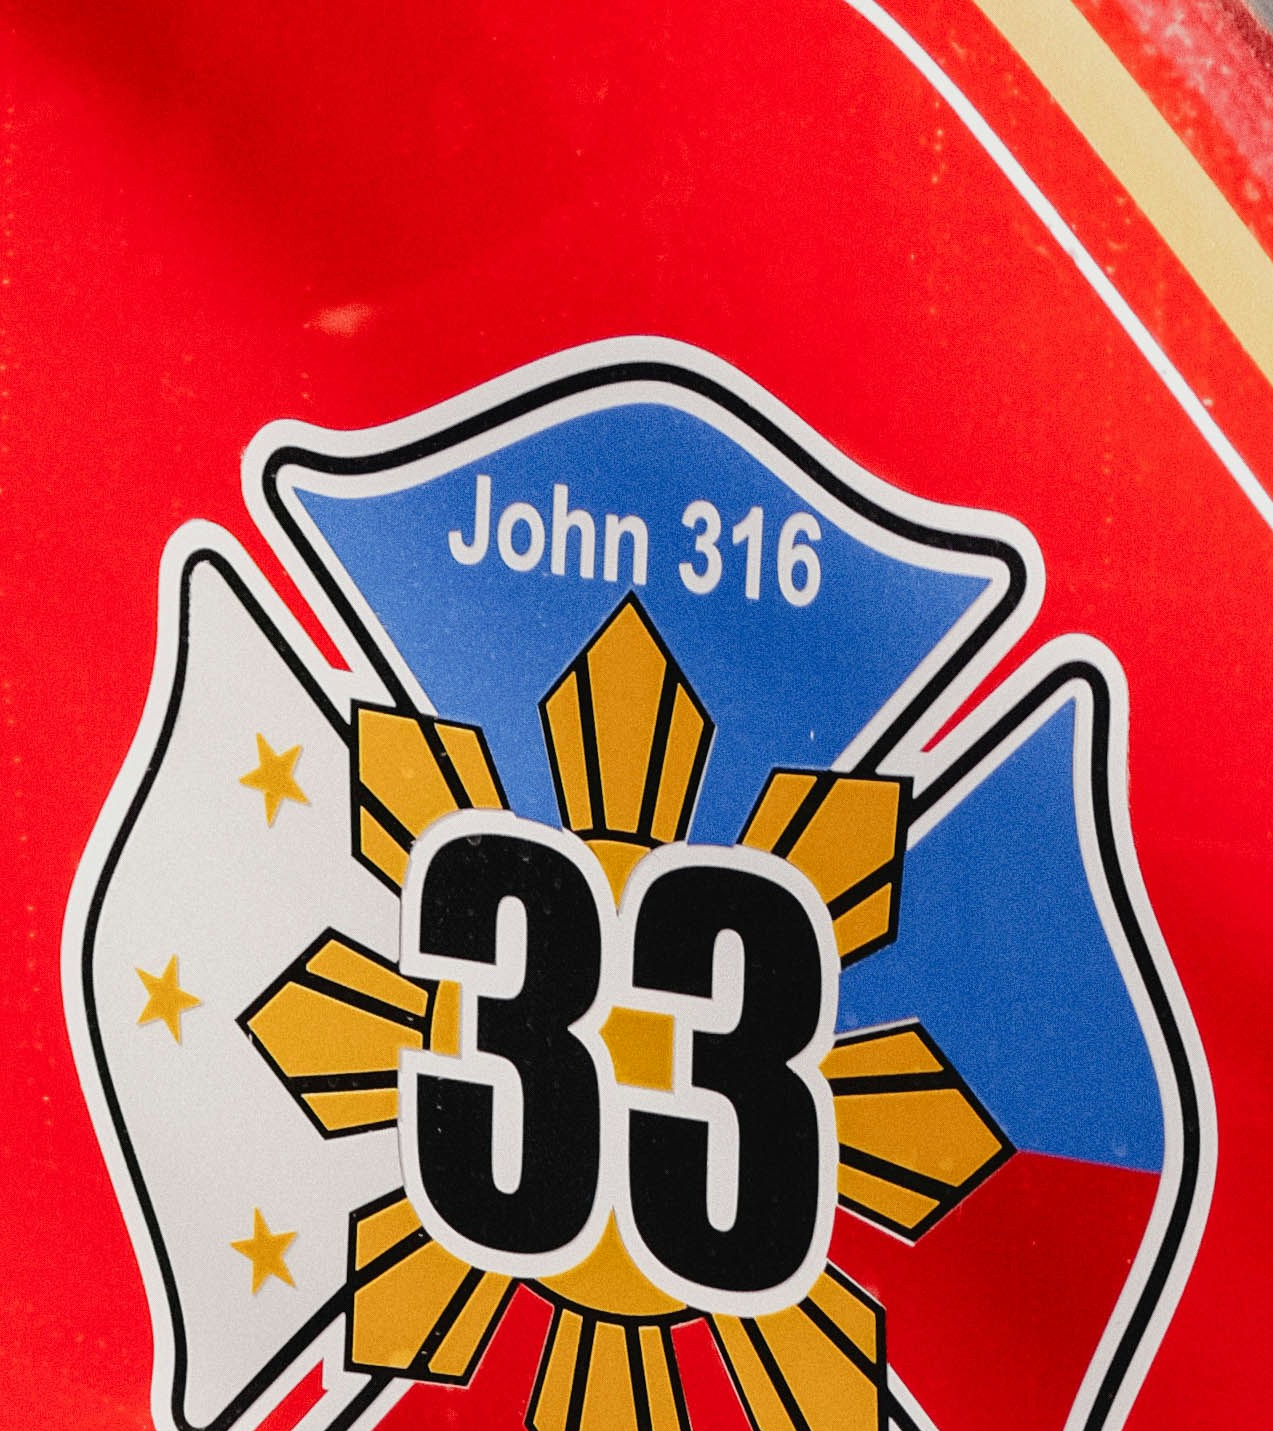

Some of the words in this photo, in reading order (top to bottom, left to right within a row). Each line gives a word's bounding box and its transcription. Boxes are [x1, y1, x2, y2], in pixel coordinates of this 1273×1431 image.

[448, 474, 650, 587] John
[678, 500, 823, 607] 316
[415, 832, 824, 1294] 33
